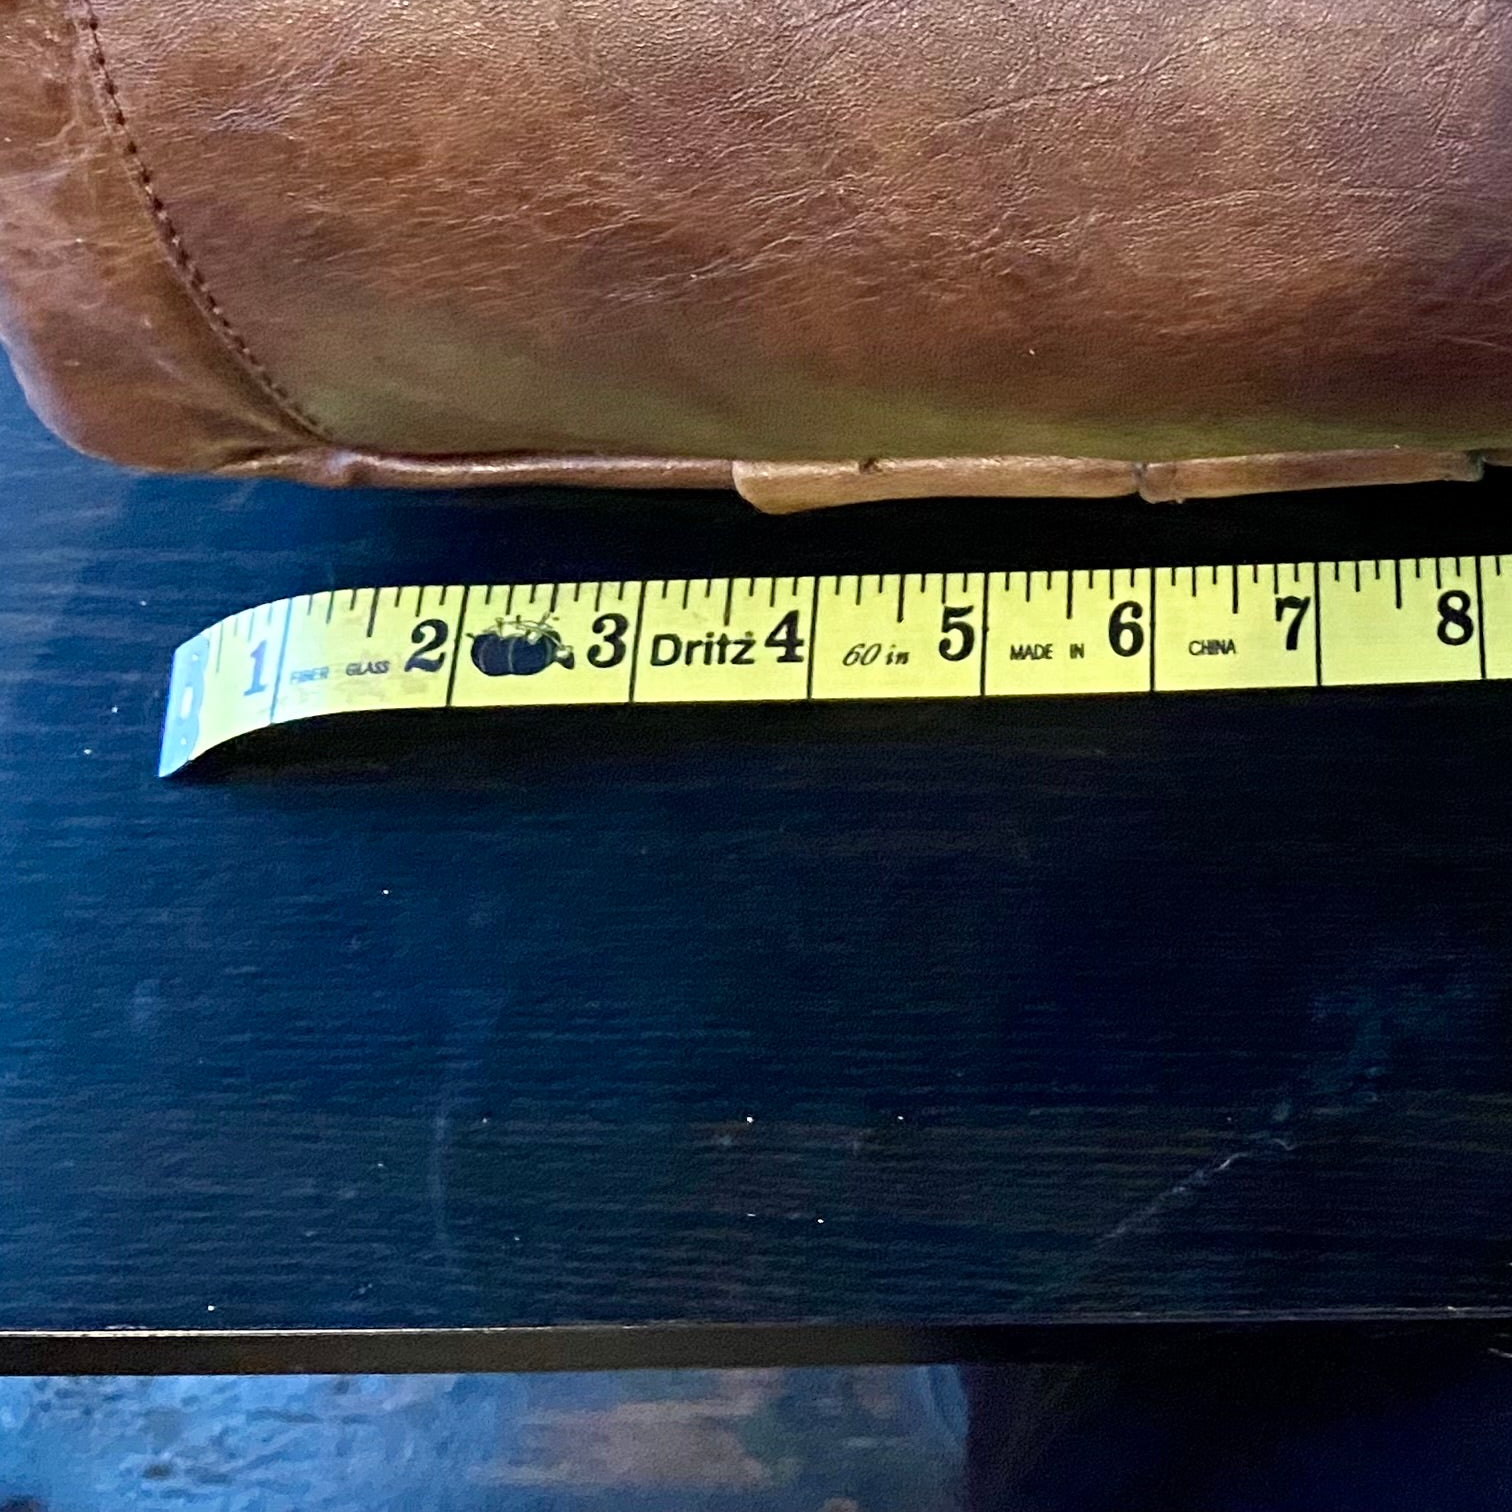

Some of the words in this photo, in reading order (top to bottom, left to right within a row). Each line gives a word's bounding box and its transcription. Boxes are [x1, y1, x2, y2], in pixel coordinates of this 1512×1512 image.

[244, 640, 267, 696] 1
[345, 661, 390, 676] GLASS
[404, 619, 448, 672] 2
[587, 613, 628, 668] 3
[650, 630, 756, 668] Dritz
[764, 610, 803, 664] 4
[842, 643, 881, 667] 60
[885, 644, 909, 666] in
[938, 605, 974, 661] 5
[1010, 642, 1053, 661] MADE
[1069, 642, 1084, 660] IN
[1108, 601, 1144, 657] 6
[1189, 639, 1236, 656] CHINA
[1275, 595, 1310, 651] 7
[1436, 590, 1473, 645] 8
